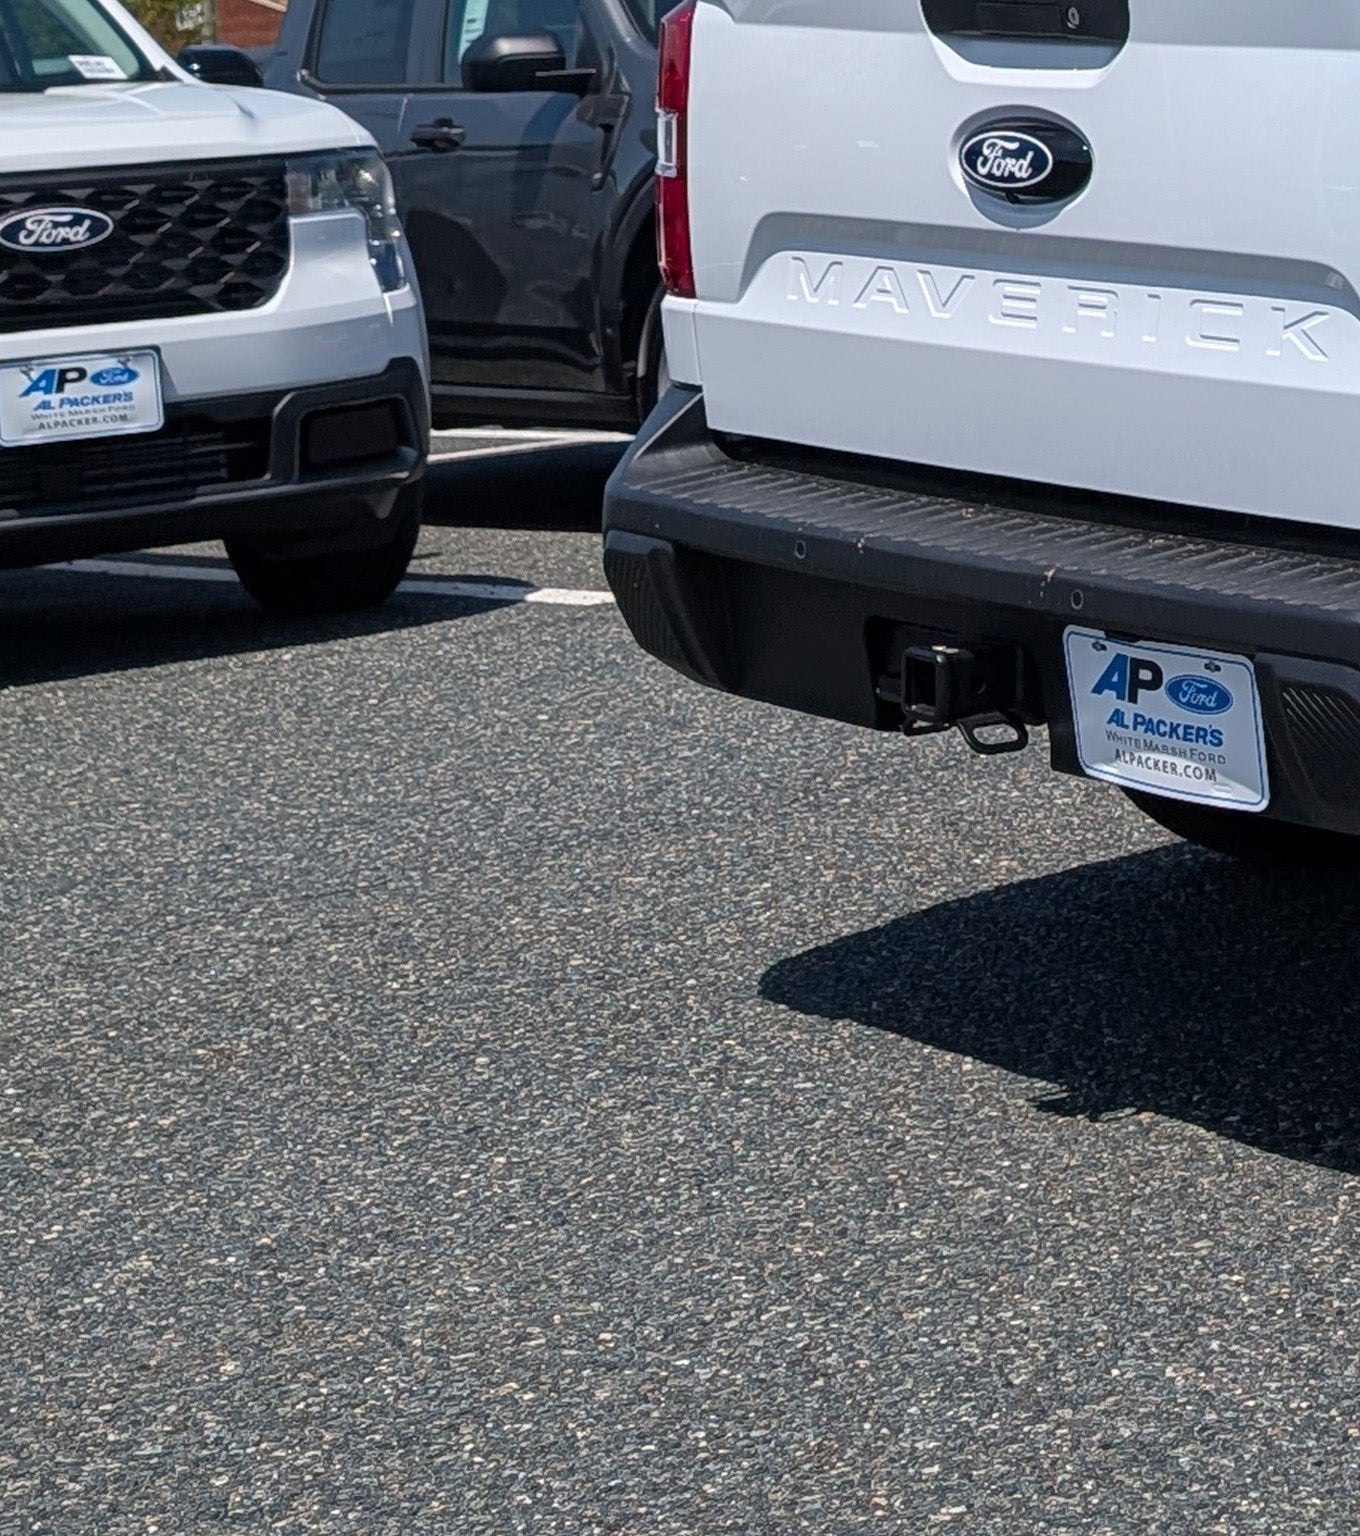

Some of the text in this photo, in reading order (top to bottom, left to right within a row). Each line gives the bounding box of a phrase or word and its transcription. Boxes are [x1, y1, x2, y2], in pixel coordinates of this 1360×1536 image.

[977, 138, 1034, 178] Ford
[19, 214, 92, 244] Ford
[787, 256, 1330, 362] MAVERICK
[19, 367, 88, 398] AP
[33, 399, 55, 412] AL
[1091, 653, 1218, 707] AP Ford
[1106, 708, 1224, 748] AL PACKER'S
[1114, 748, 1218, 783] ALPACKER.COM
